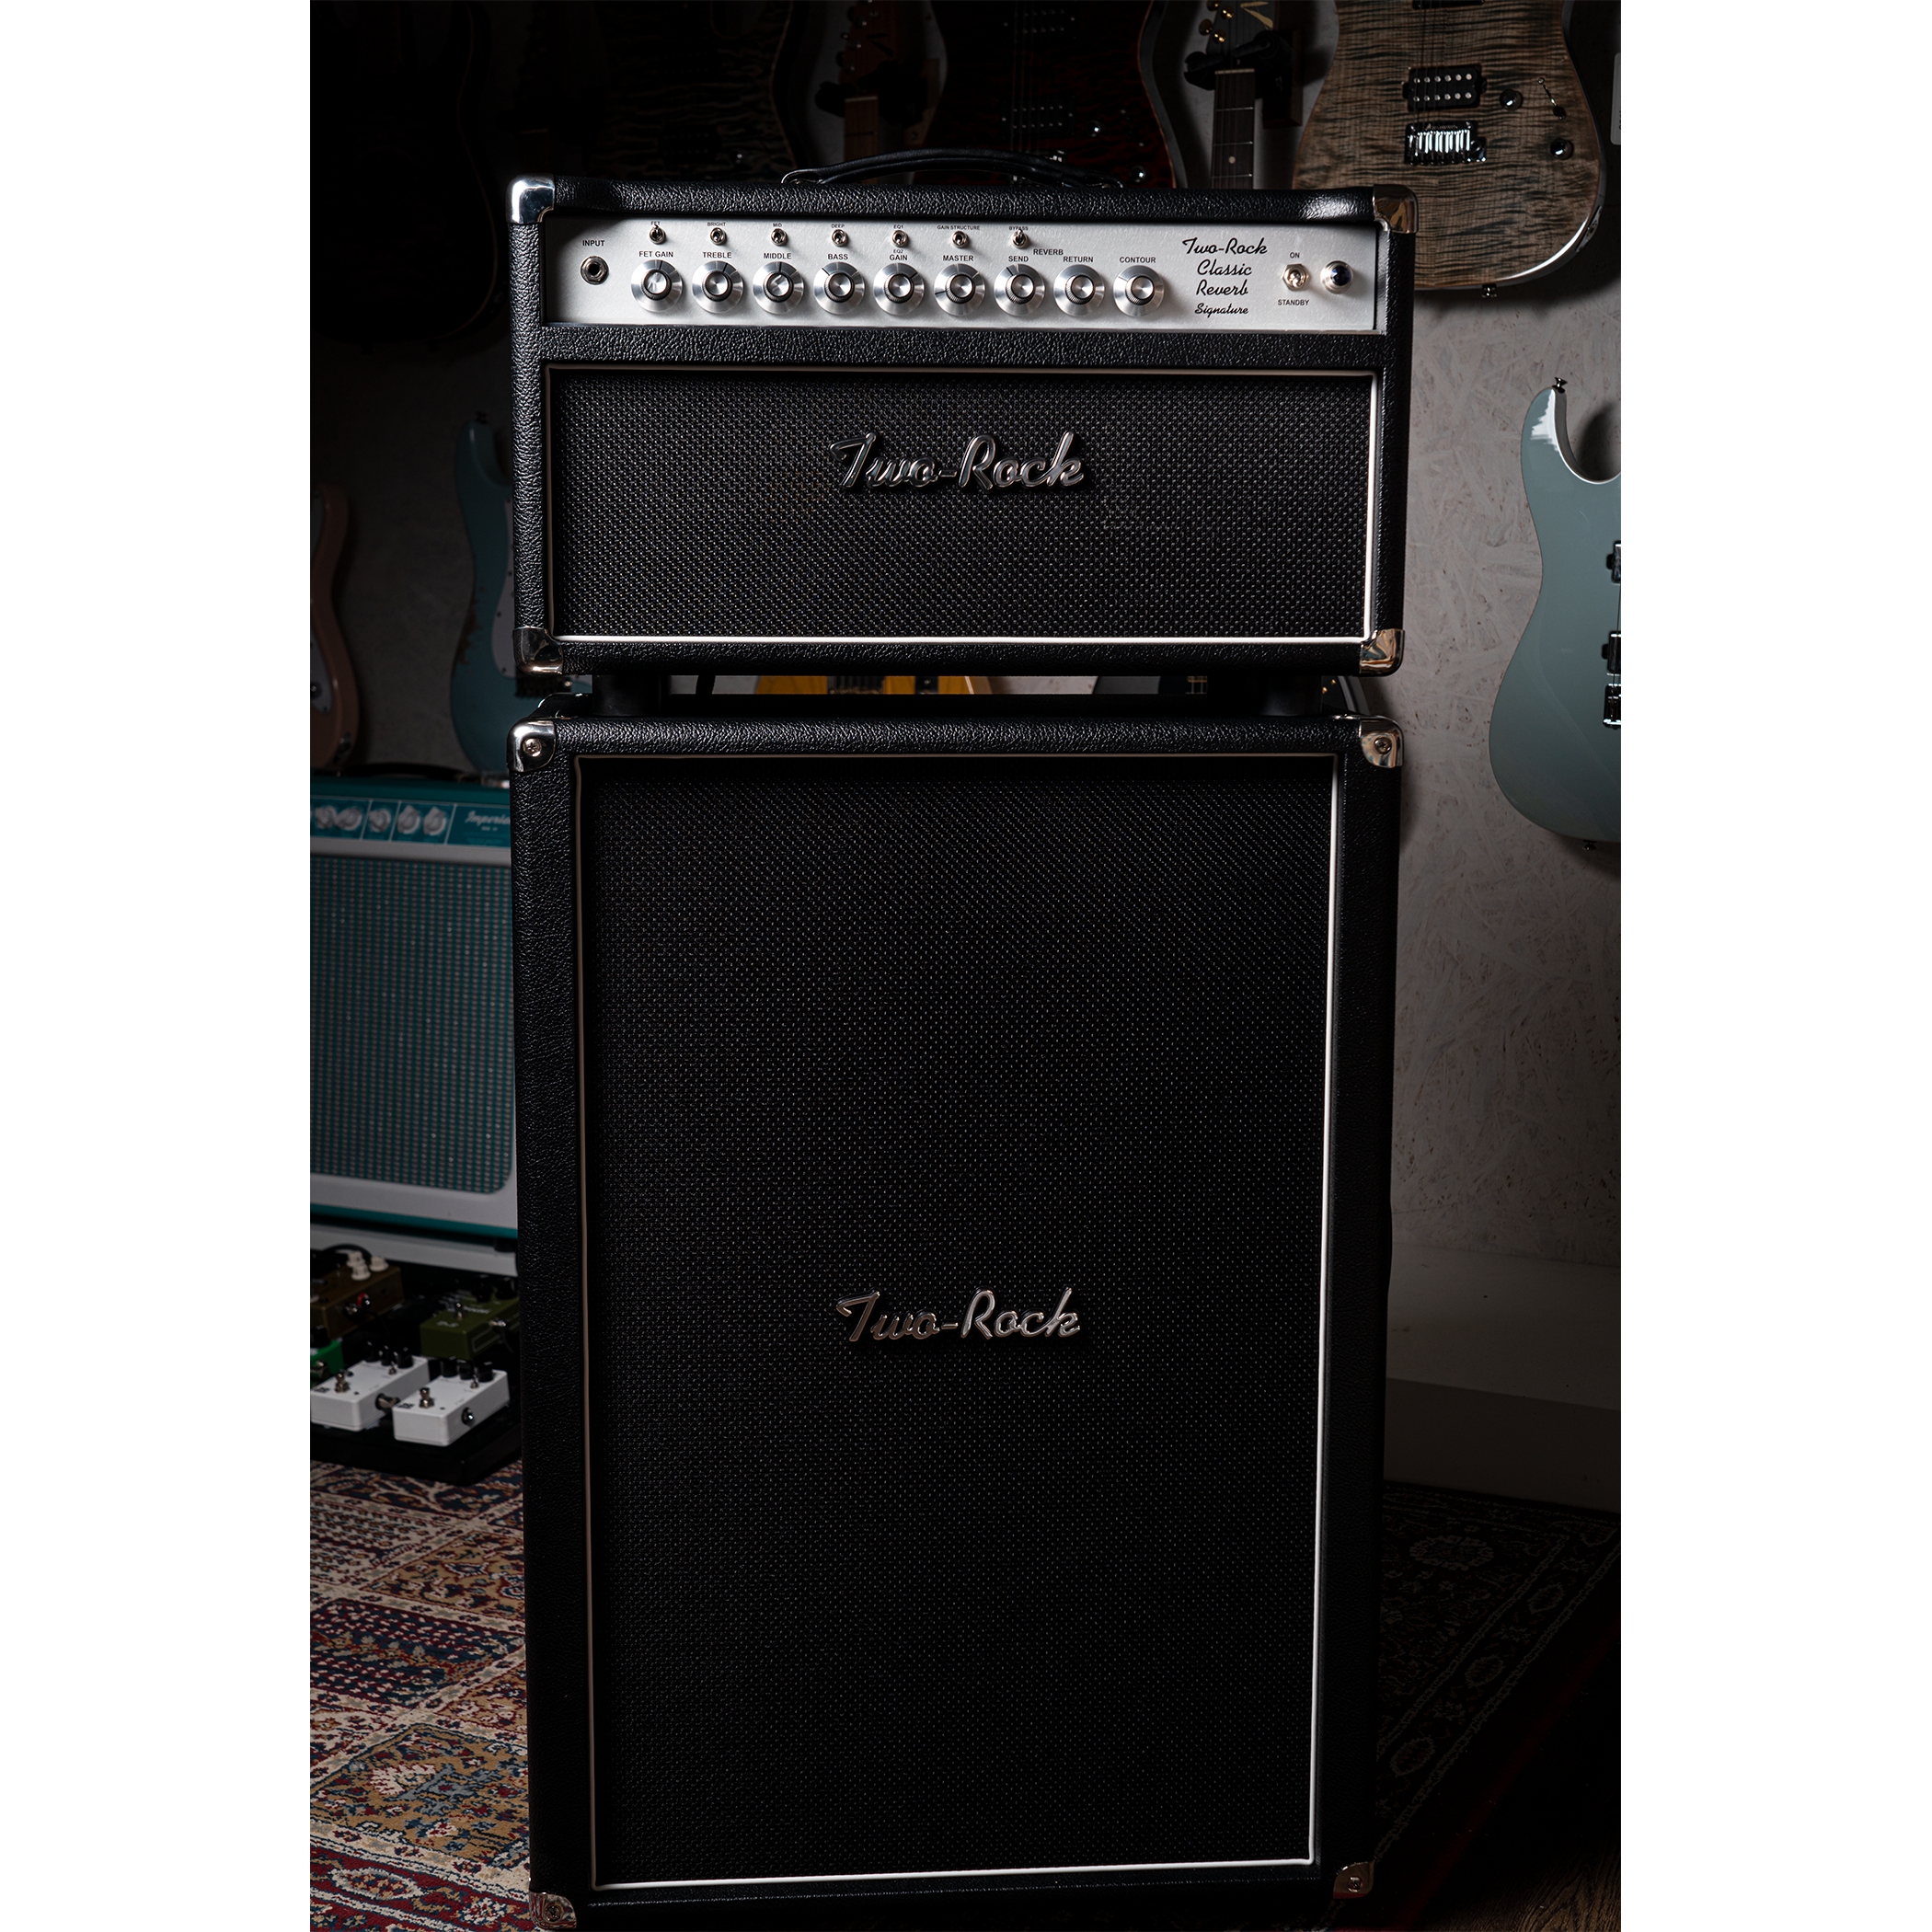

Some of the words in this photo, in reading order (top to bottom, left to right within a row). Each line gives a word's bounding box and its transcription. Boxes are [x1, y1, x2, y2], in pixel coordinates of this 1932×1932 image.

[581, 239, 605, 247] INPUT
[1181, 236, 1268, 255] Two-Rock
[1007, 255, 1029, 263] SEND
[1119, 256, 1156, 264] CONTOUR
[1196, 259, 1253, 276] Classic
[1195, 279, 1249, 296] Reverb
[1194, 302, 1249, 318] Signature
[1277, 298, 1310, 306] STANDBY
[829, 431, 1085, 490] Two-Rock
[834, 1286, 1081, 1342] Two-Rock
